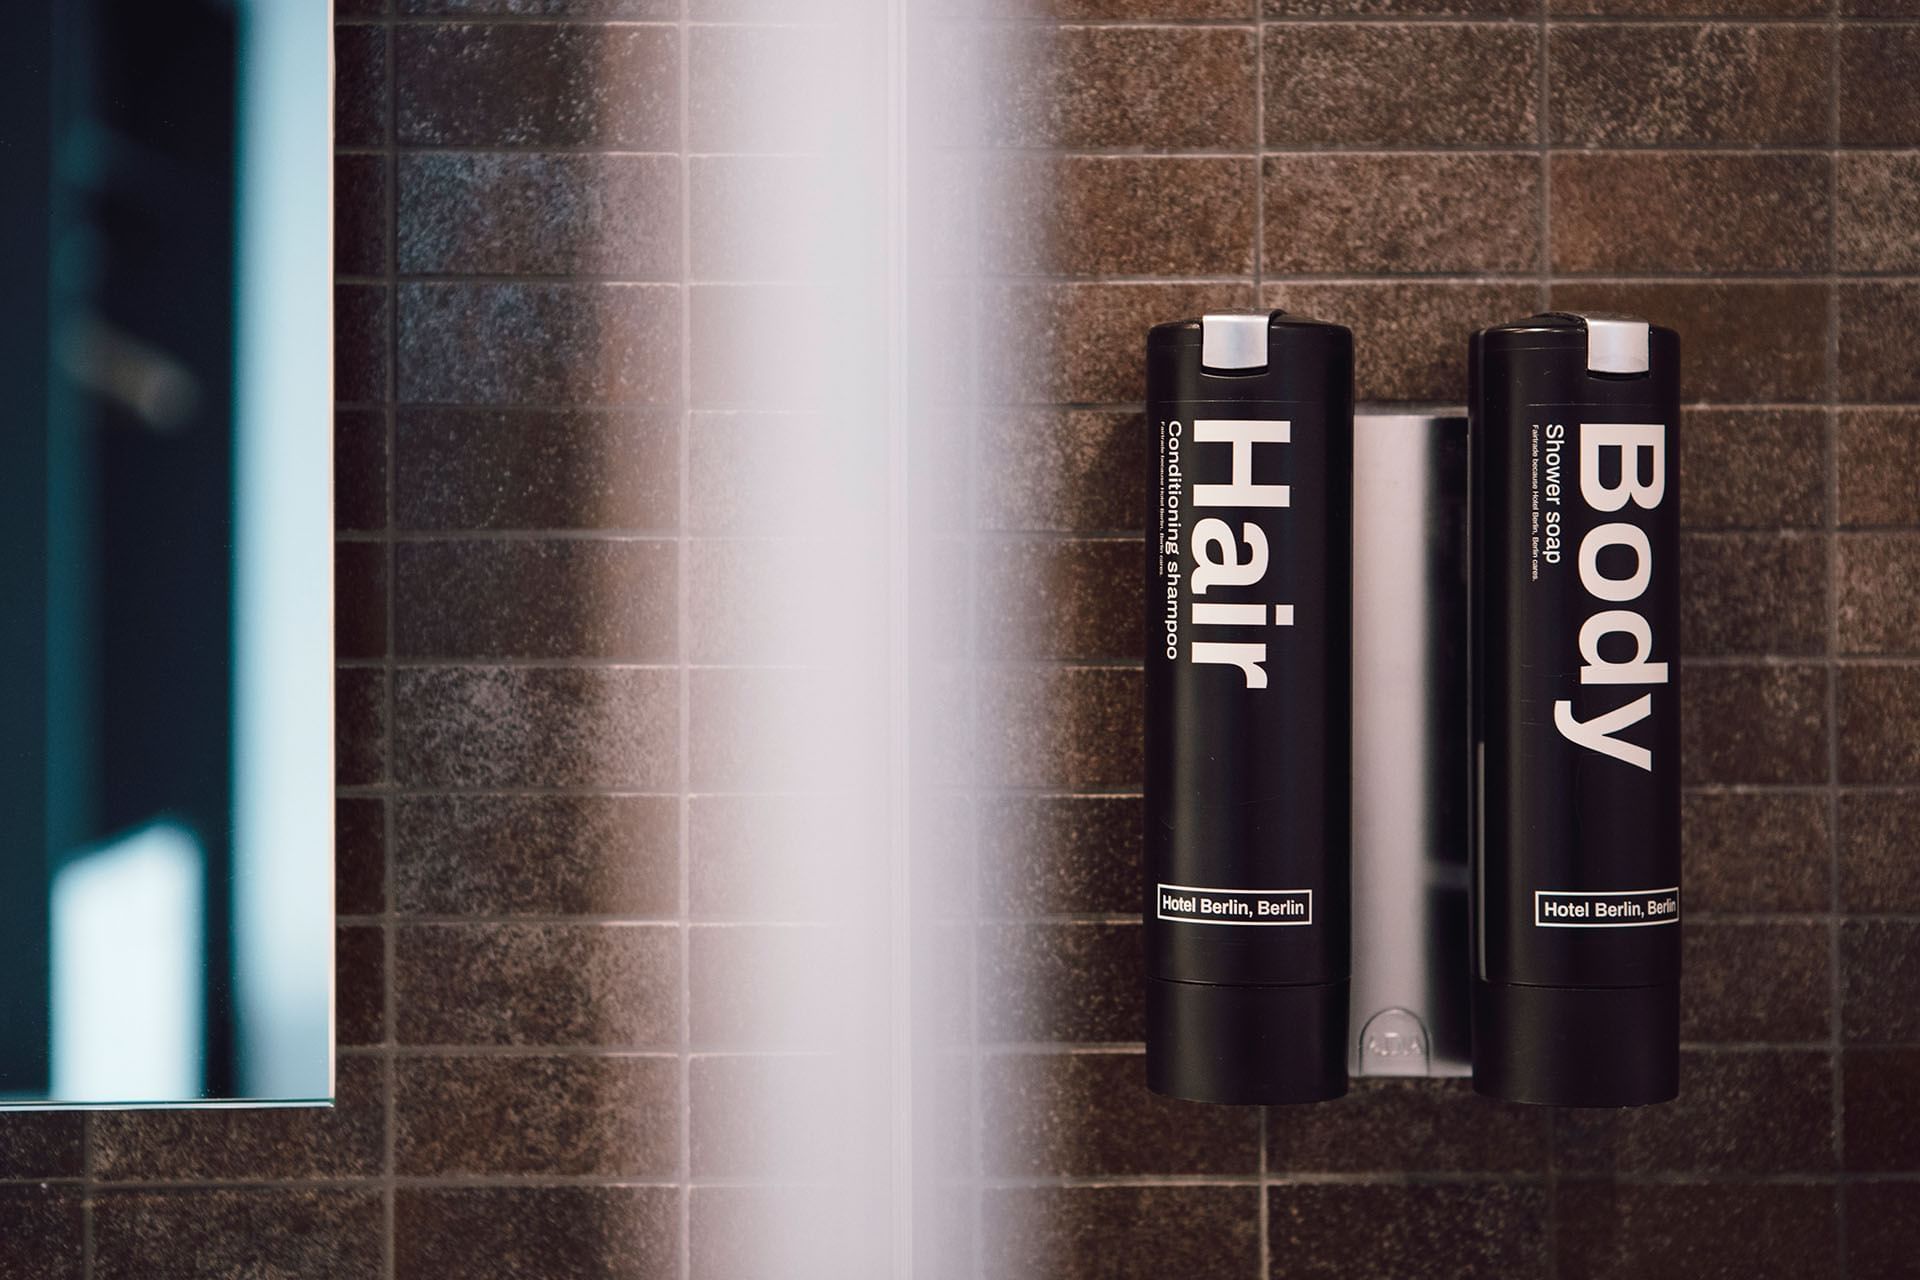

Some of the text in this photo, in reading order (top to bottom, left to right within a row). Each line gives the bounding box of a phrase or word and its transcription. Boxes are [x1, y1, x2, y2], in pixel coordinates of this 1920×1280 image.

[1164, 420, 1182, 660] Conditioning shampoo
[1191, 420, 1294, 689] Hair
[1530, 424, 1540, 582] Fairtrade because Hotel Berlin, Berlin cares.
[1542, 424, 1565, 564] Shower soap
[1554, 423, 1668, 772] Body
[1162, 894, 1304, 918] Hotel Berlin, Berlin
[1544, 897, 1676, 919] Hotel Berlin, Berlin
